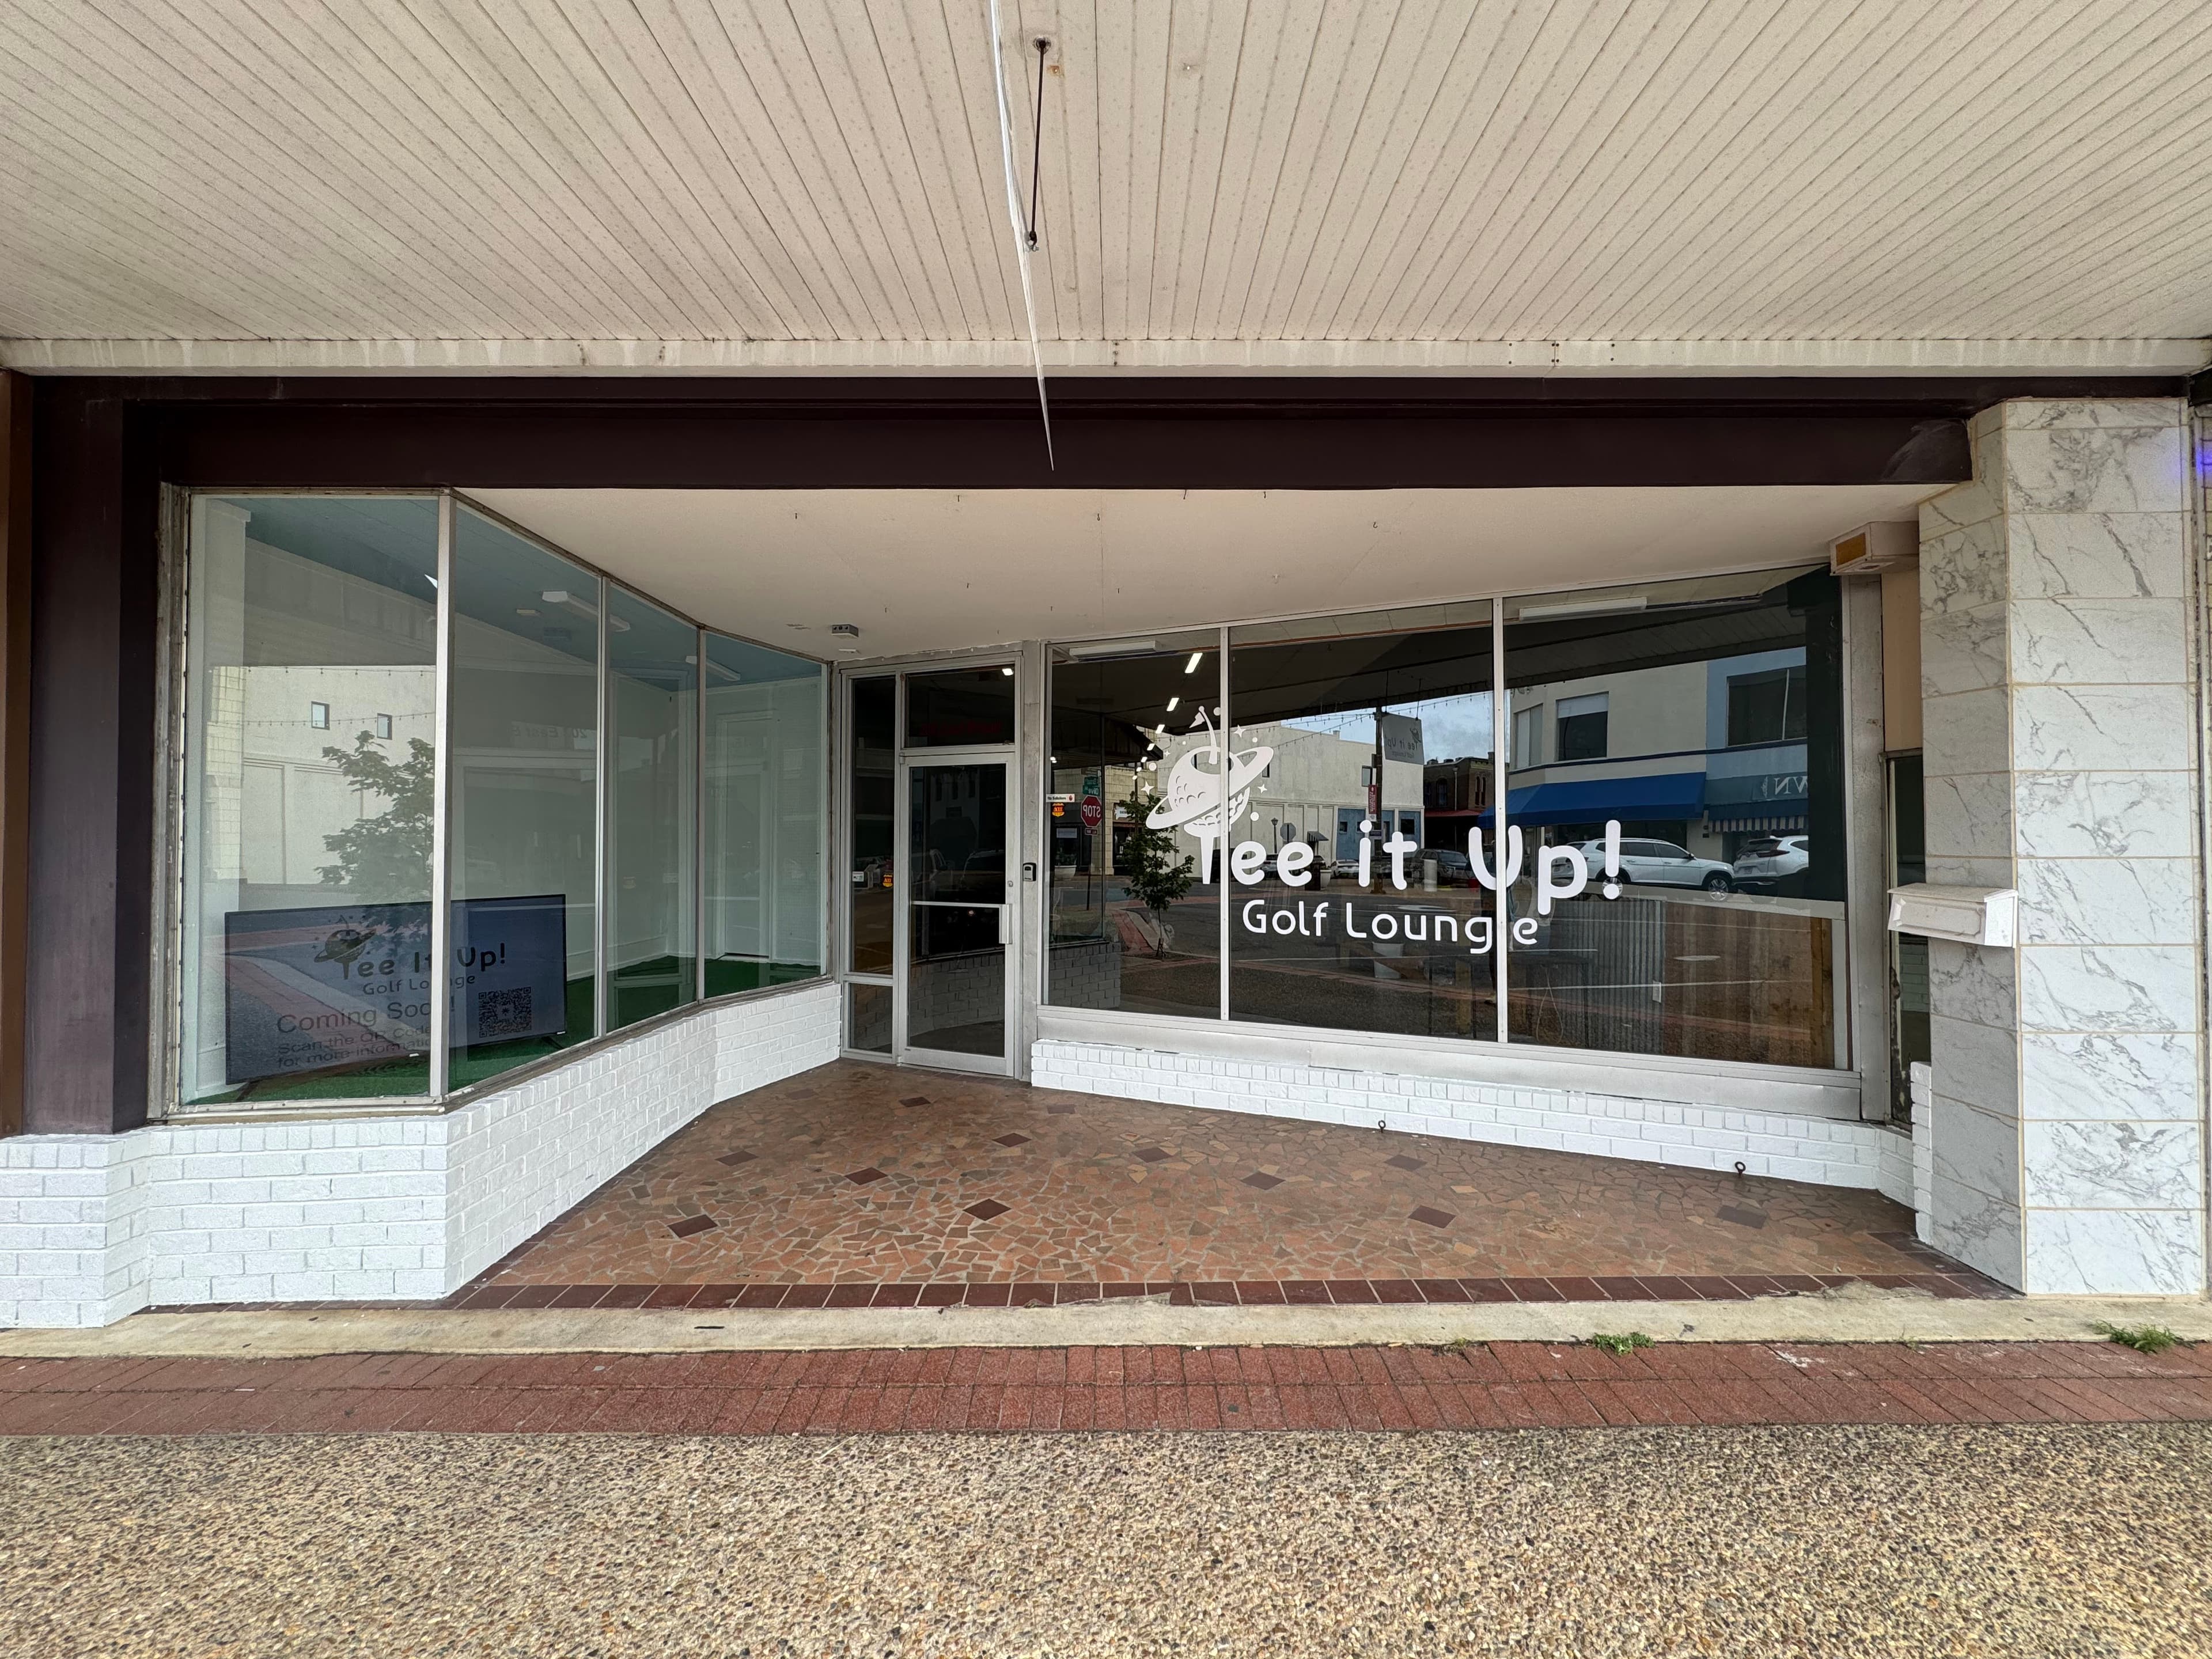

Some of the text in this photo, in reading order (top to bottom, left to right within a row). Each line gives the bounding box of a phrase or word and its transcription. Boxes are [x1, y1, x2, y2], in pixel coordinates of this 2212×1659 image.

[1358, 820, 1418, 891] it
[1468, 819, 1621, 915] Up!
[1243, 899, 1538, 955] Golf Lounge
[457, 942, 505, 972] Up!
[363, 975, 475, 995] Golf Loge
[277, 1008, 377, 1033] Coming
[278, 1041, 323, 1054] Scan
[328, 1036, 354, 1047] the
[277, 1057, 299, 1067] for
[307, 1051, 350, 1063] more
